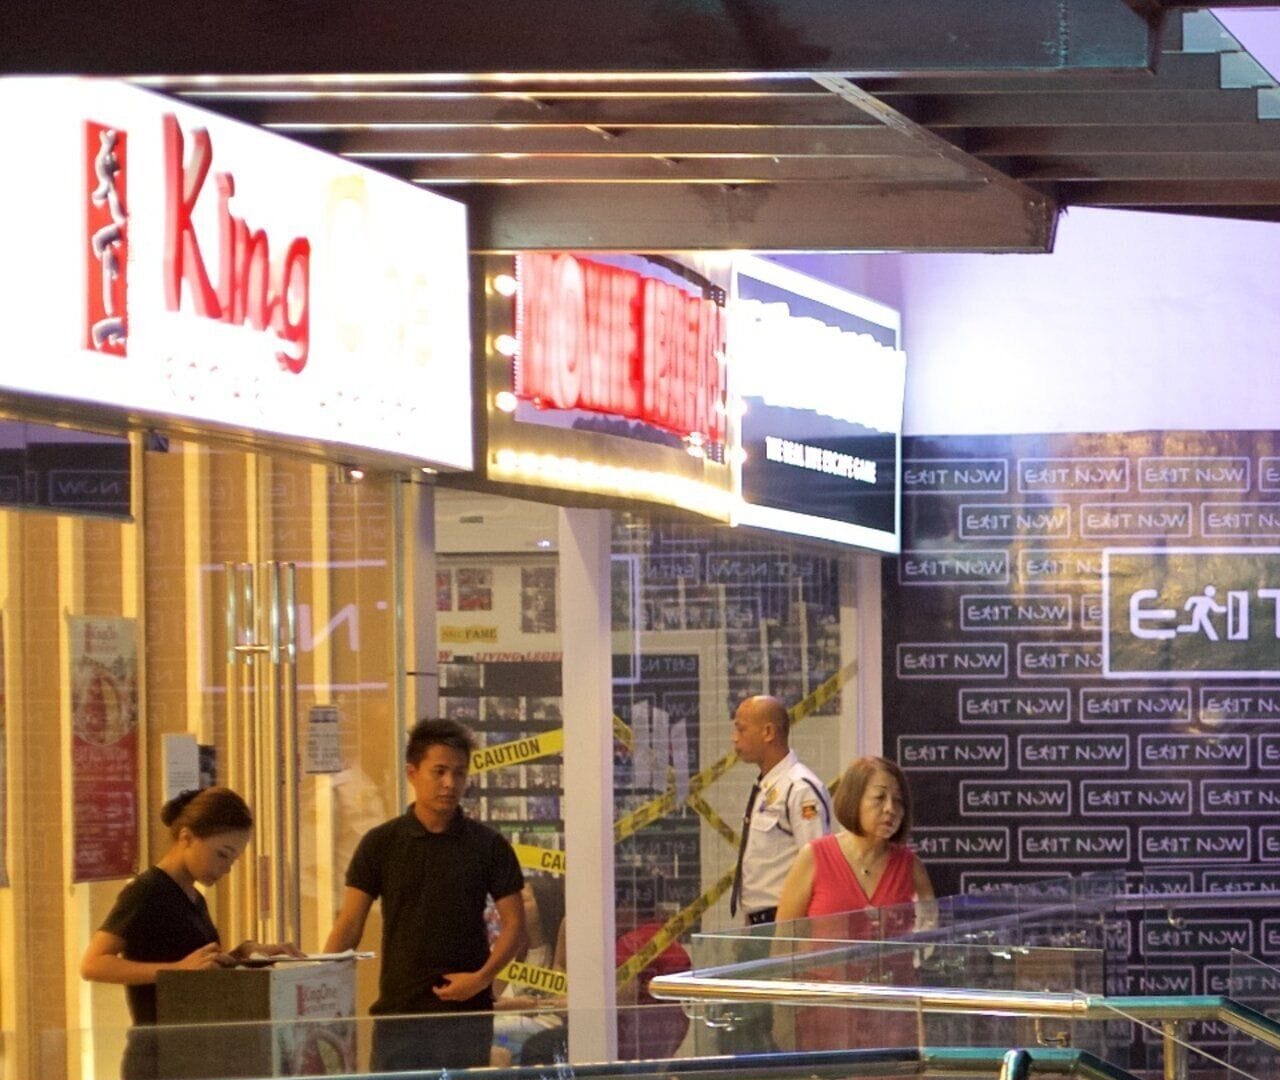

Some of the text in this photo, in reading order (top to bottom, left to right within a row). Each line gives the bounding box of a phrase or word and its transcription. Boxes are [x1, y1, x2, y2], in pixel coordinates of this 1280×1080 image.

[163, 112, 312, 375] King
[954, 470, 1002, 484] NOW
[1074, 469, 1123, 484] NOW
[1195, 468, 1244, 483] NOW
[1016, 515, 1066, 530] NOW
[1137, 514, 1186, 529] NOW
[955, 561, 1004, 576] NOW
[1018, 605, 1067, 620] NOW
[954, 654, 1002, 669] NOW
[1017, 699, 1066, 714] NOW
[1137, 698, 1186, 713] NOW
[473, 737, 541, 771] CAUTION
[954, 746, 1004, 760] NOW
[1075, 745, 1124, 760] NOW
[1196, 745, 1245, 760] NOW
[1018, 791, 1066, 806] NOW
[1138, 791, 1187, 806] NOW
[955, 838, 1004, 853] NOW
[1076, 837, 1125, 852] NOW
[1197, 837, 1246, 852] NOW
[1198, 930, 1246, 945] NOW
[507, 963, 568, 993] CAUTIO
[1141, 976, 1190, 991] NOW
